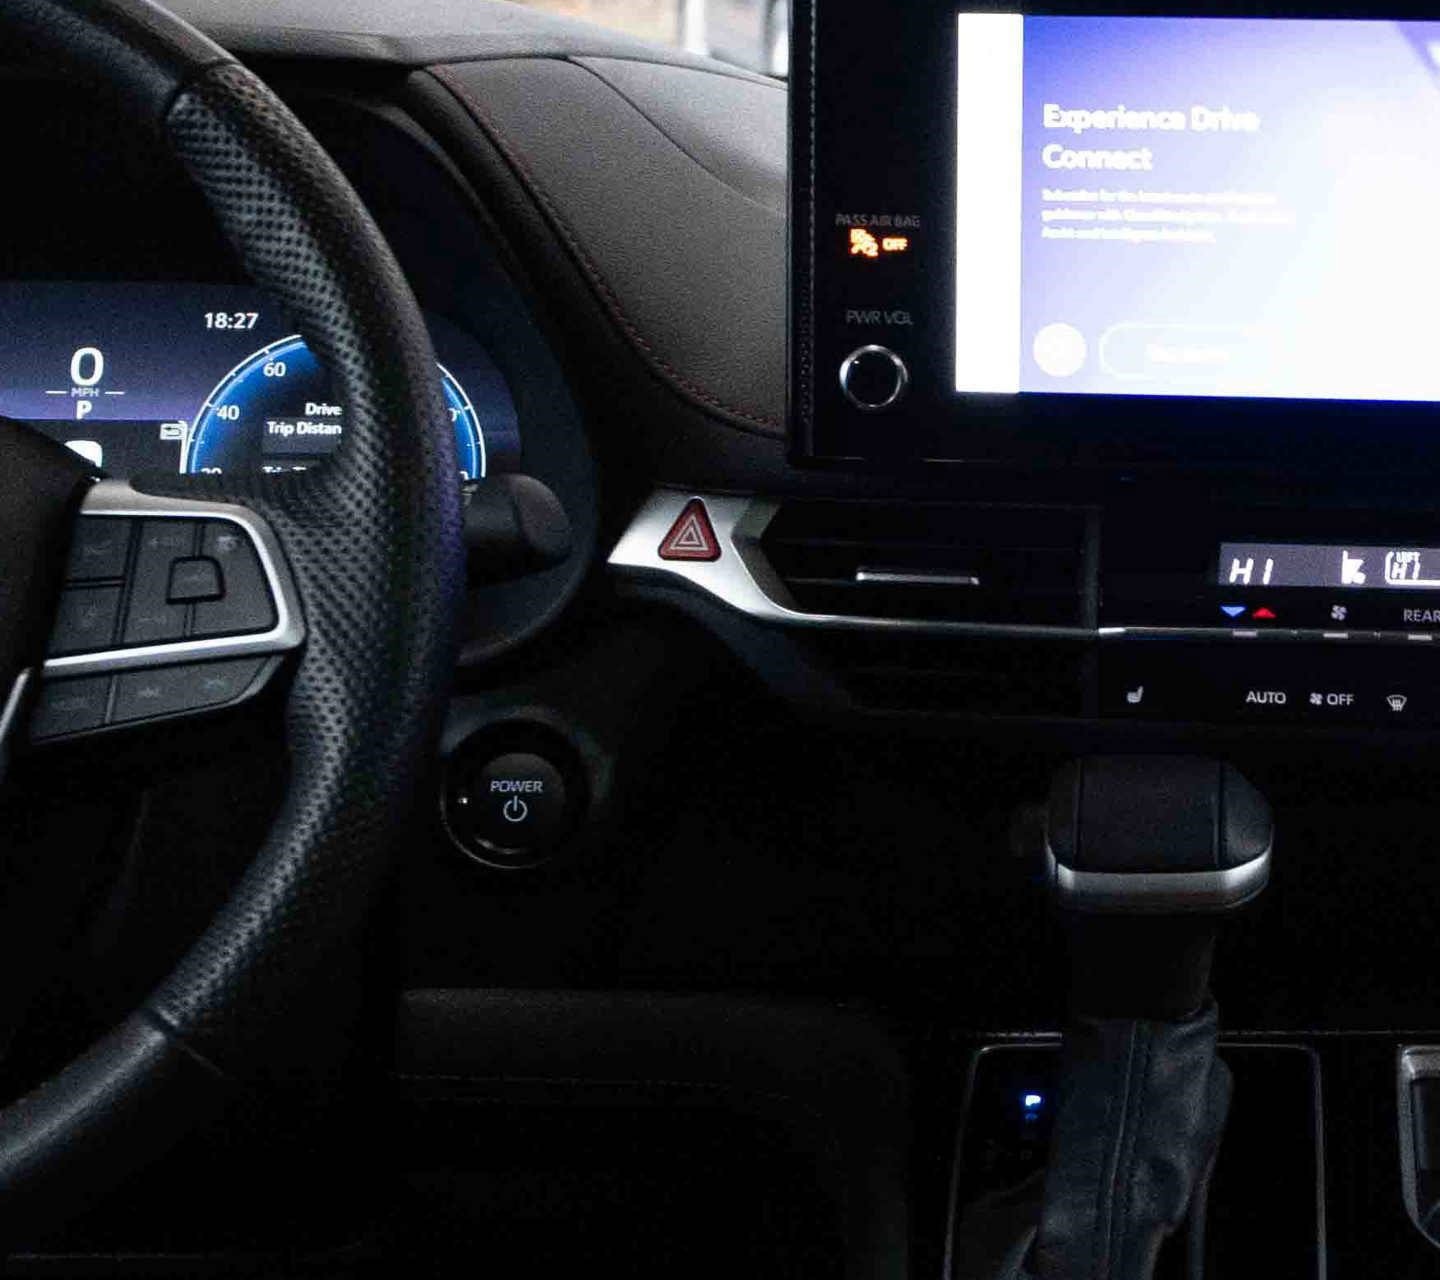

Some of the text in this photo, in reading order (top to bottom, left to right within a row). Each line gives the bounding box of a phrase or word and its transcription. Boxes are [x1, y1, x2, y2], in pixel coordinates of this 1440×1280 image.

[1042, 103, 1260, 133] Experience Drive
[1042, 144, 1152, 170] Connect
[881, 236, 909, 252] OFF
[204, 312, 259, 330] 18:27
[70, 346, 104, 386] 0
[263, 362, 286, 378] 60
[70, 387, 100, 398] MPH
[76, 401, 92, 420] P
[217, 405, 240, 420] 40
[304, 403, 343, 417] Drive
[266, 421, 294, 437] Trip
[1245, 690, 1287, 705] AUTO
[1326, 692, 1355, 706] OFF
[489, 779, 544, 793] POWER
